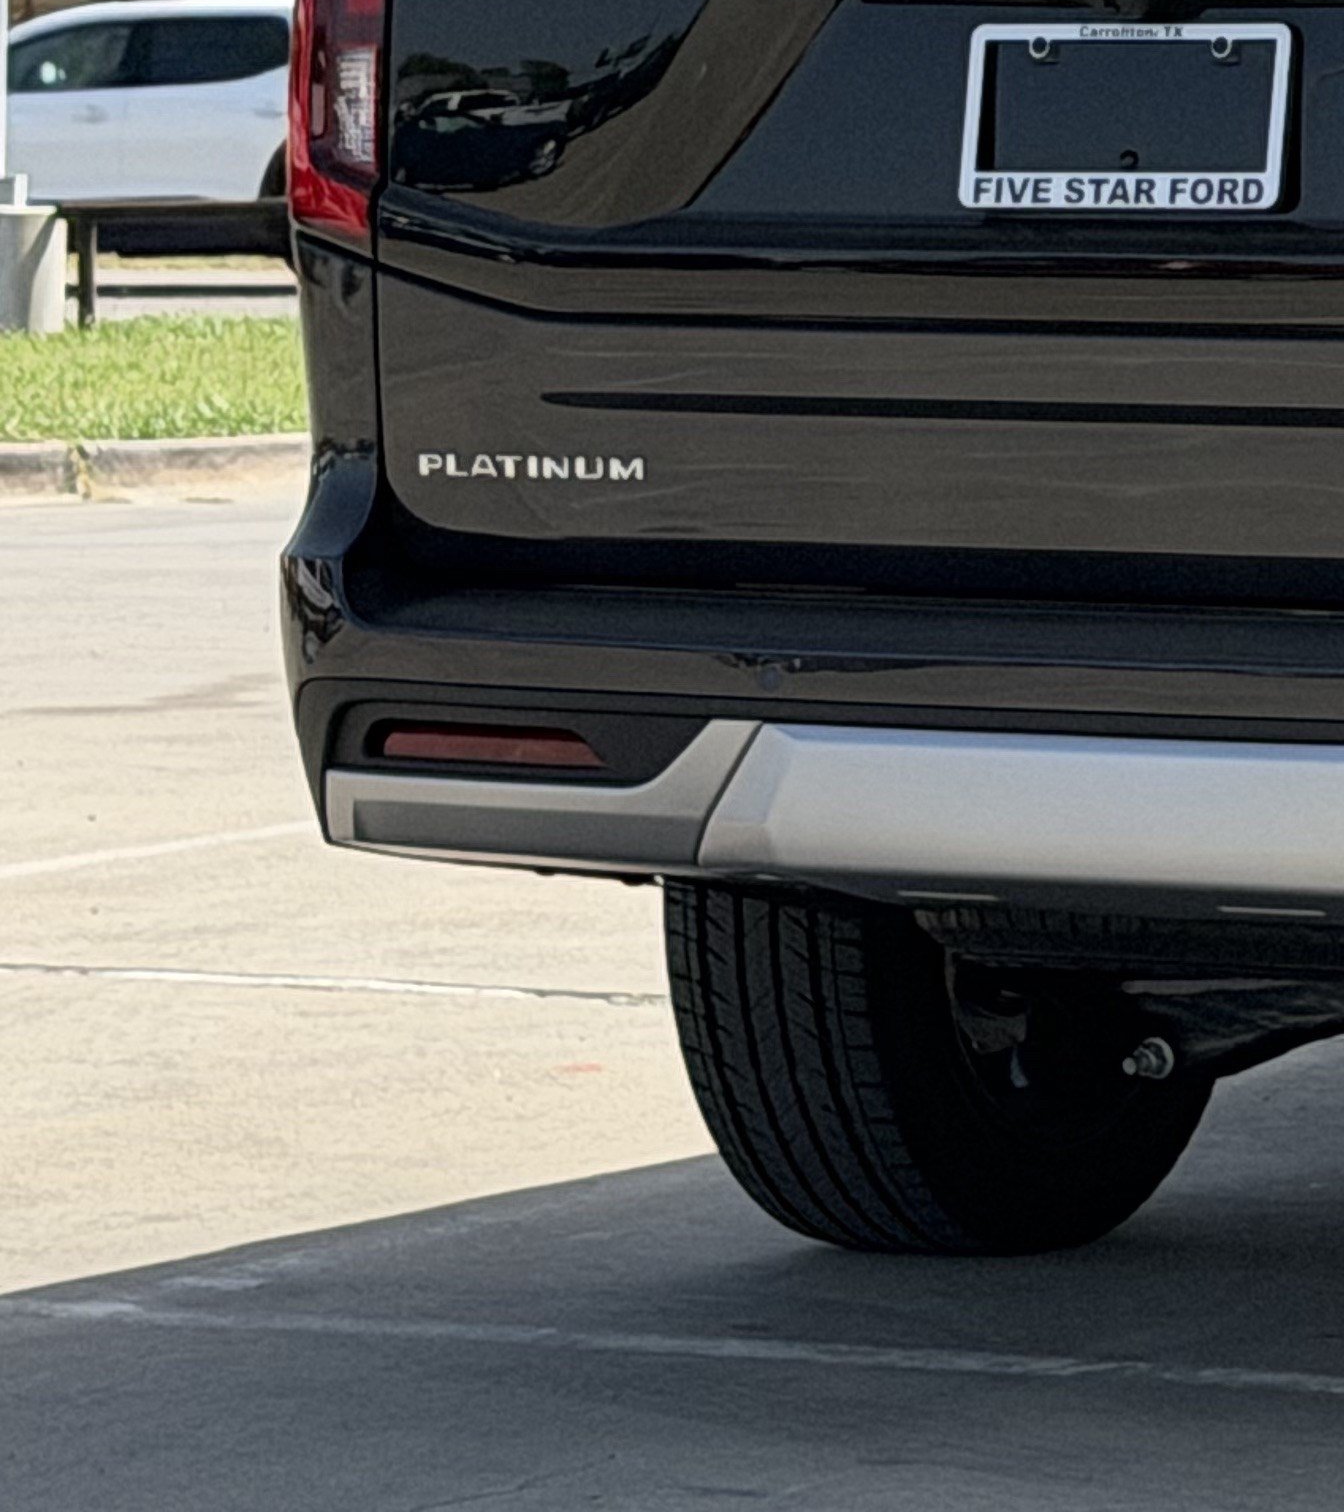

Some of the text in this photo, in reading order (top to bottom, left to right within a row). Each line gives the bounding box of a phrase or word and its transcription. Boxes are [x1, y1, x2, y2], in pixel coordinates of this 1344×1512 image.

[972, 177, 1265, 205] FIVE STAR FORD
[418, 453, 645, 481] PLATINUM
